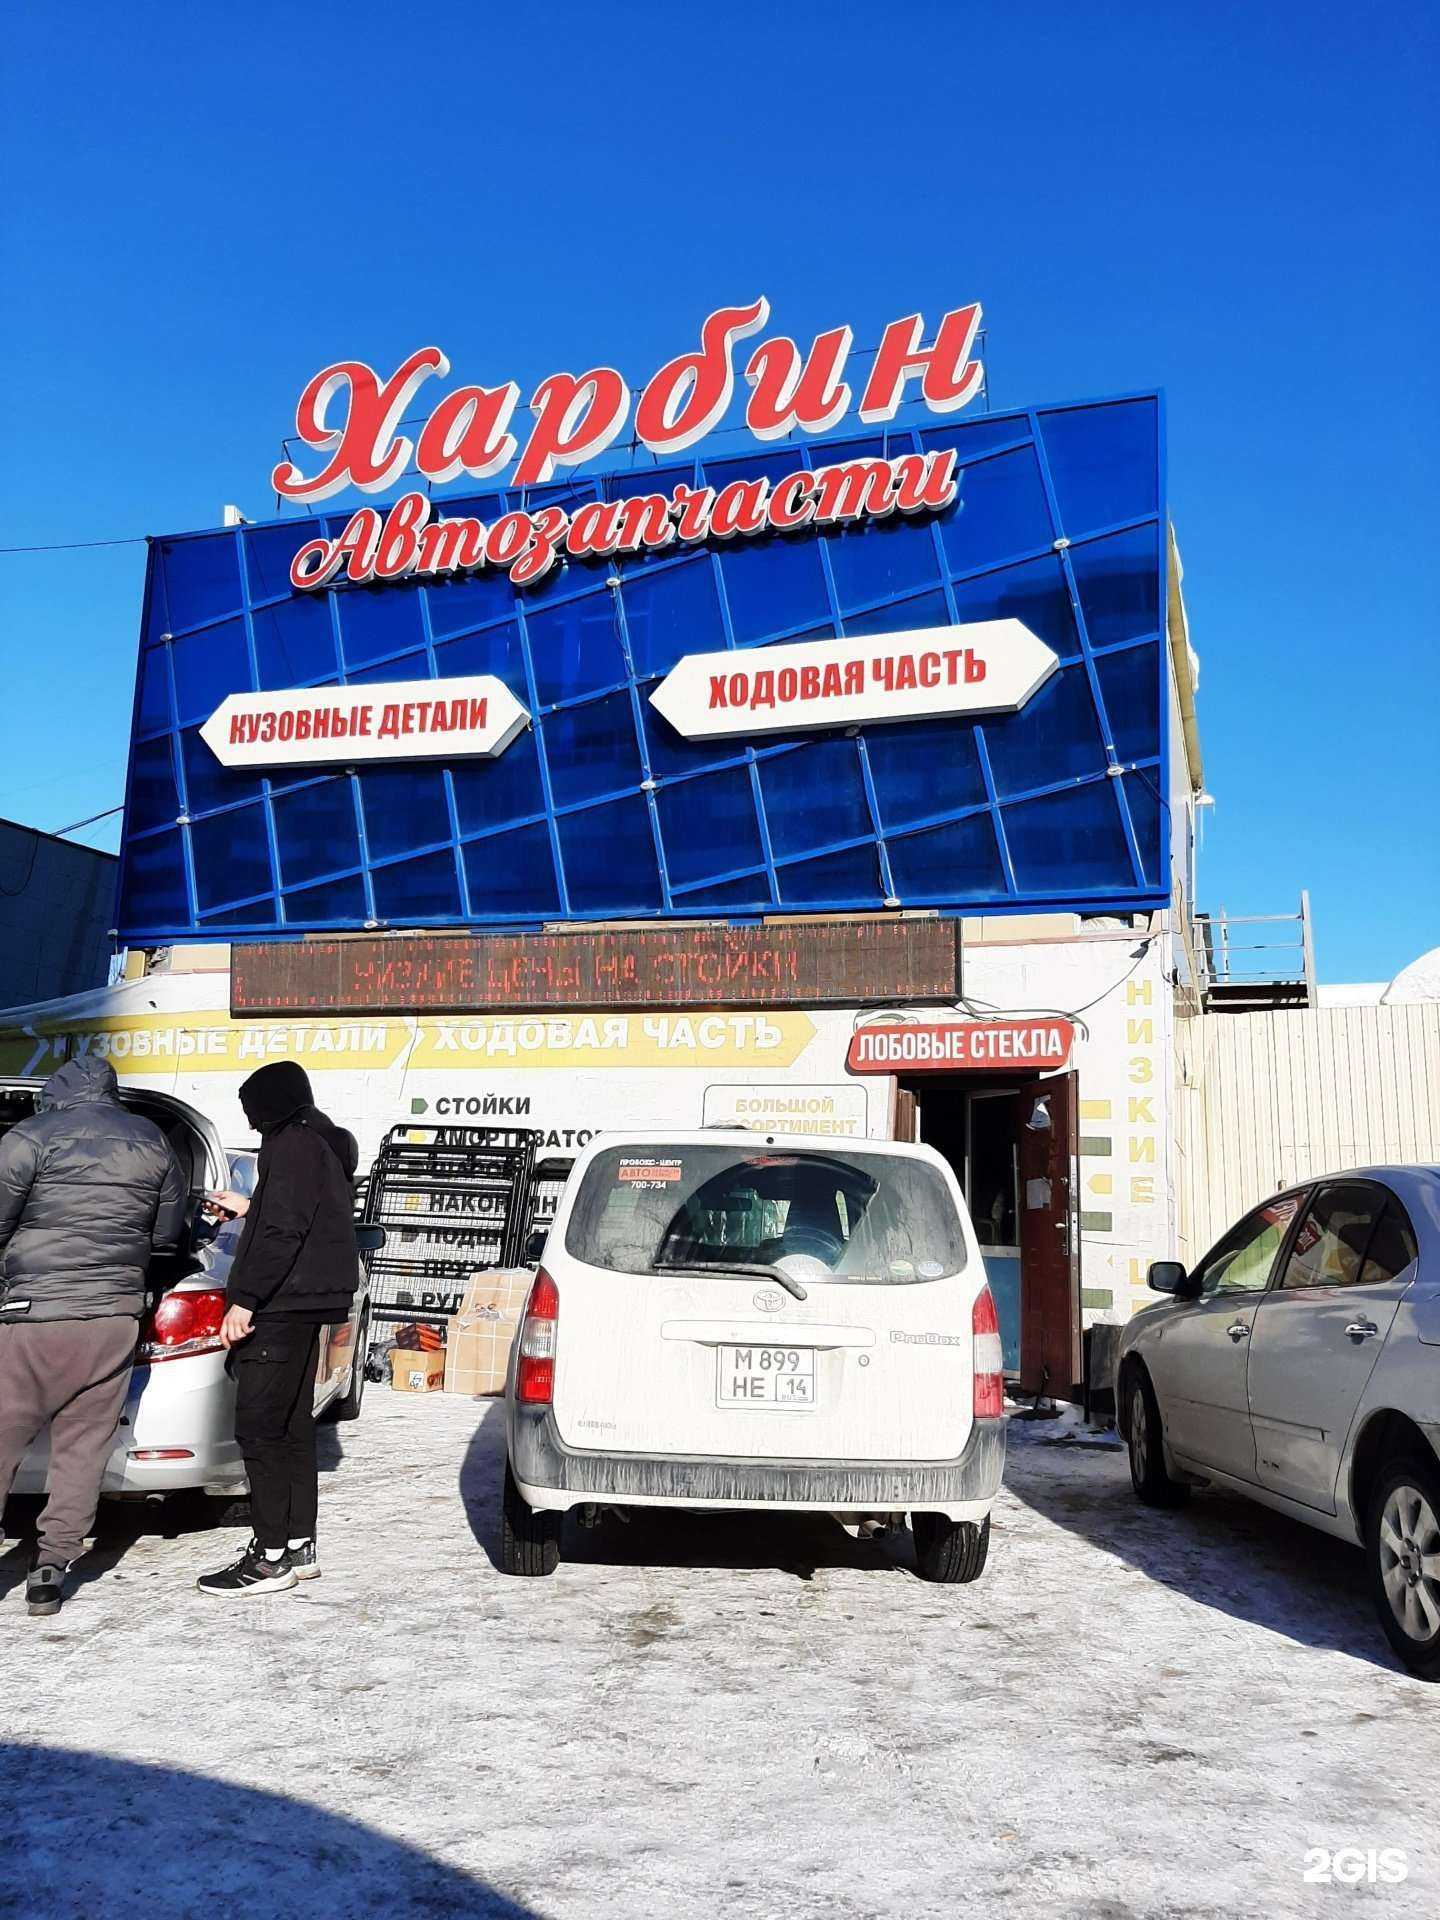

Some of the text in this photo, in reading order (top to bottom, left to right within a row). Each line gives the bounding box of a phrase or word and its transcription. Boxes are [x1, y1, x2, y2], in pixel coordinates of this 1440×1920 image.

[271, 296, 985, 504] Харбин
[290, 447, 960, 588] Автозапчасти
[708, 648, 988, 711] ХОДОВАЯ ЧАСТЬ
[229, 697, 489, 745] КУЗОВНЫЕ ДЕТАЛИ
[239, 1023, 387, 1058] ДЕТАЛИ
[433, 1014, 784, 1056] ХОДОВАЯ ЧАСТЬ
[857, 1028, 1063, 1062] ЛОБОВЫЕ СТЕКЛА
[436, 1093, 531, 1115] СТОЙКИ
[735, 1095, 834, 1114] БОЛЬШОЙ
[434, 1129, 603, 1148] АМОРТИЗАТО
[631, 1180, 667, 1189] 700-734
[735, 1348, 800, 1372] М 899
[732, 1375, 765, 1398] НЕ
[786, 1378, 807, 1396] 14
